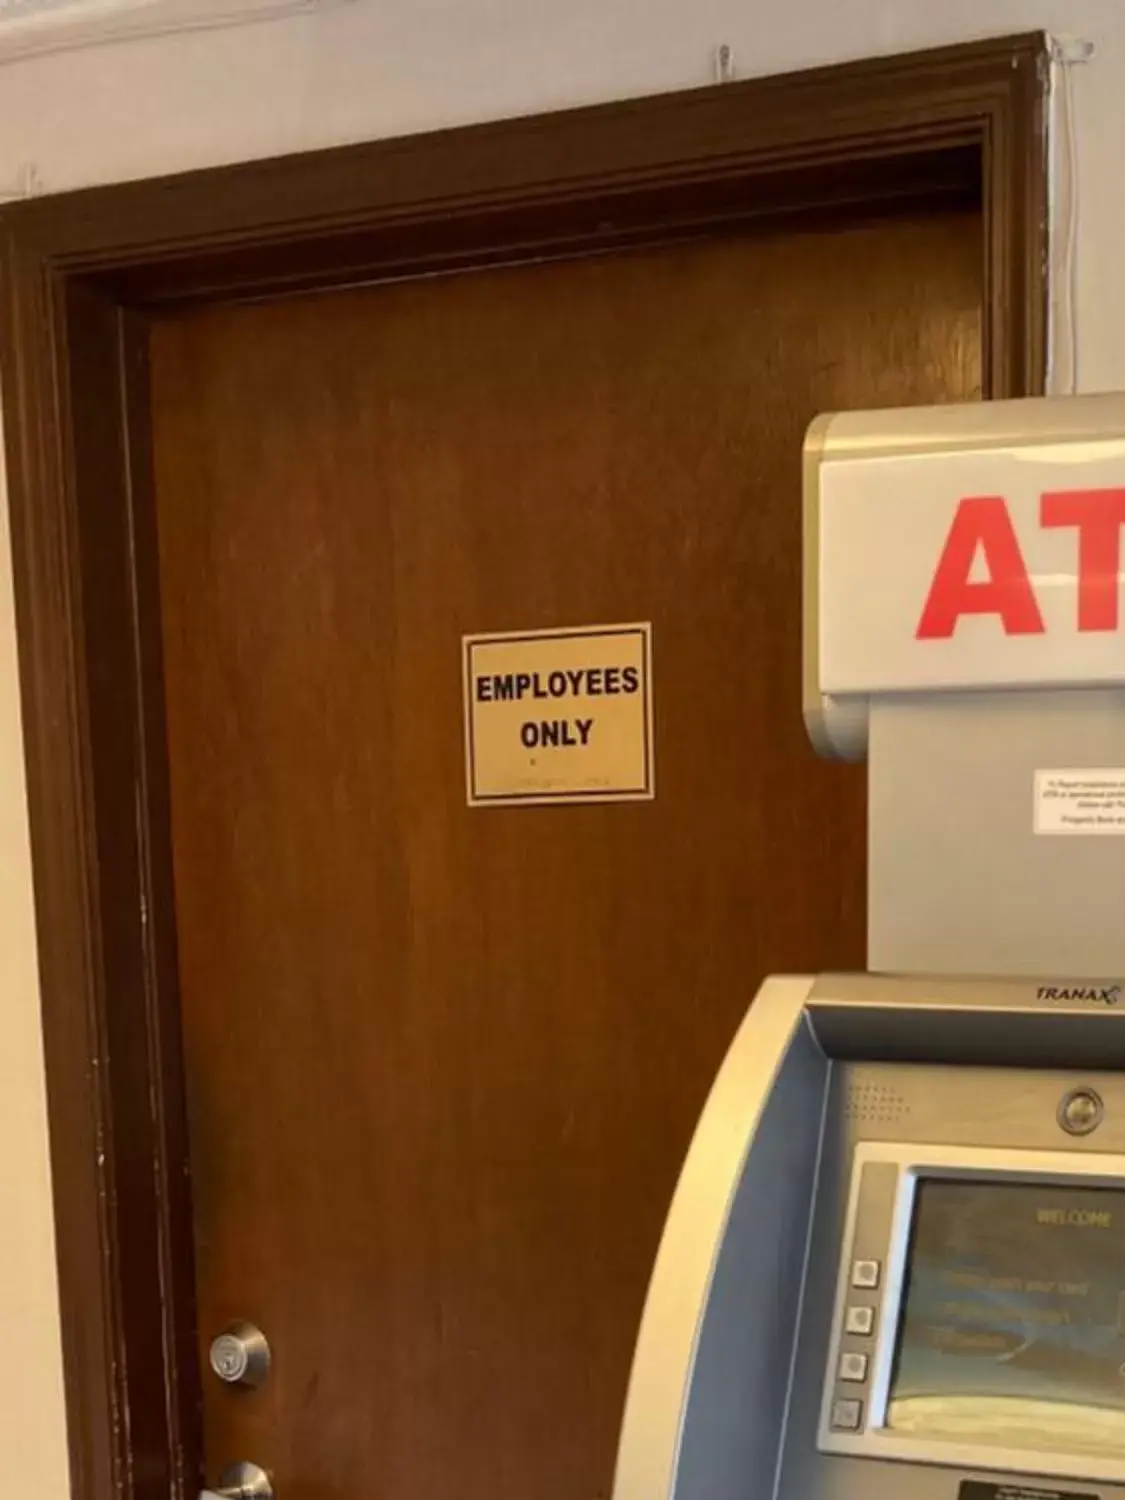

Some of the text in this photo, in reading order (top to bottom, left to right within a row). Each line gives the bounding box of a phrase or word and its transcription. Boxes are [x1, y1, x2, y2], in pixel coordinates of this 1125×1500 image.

[476, 667, 639, 702] EMPLOYEES
[521, 719, 593, 748] ONLY
[1036, 1209, 1112, 1229] WELCOME
